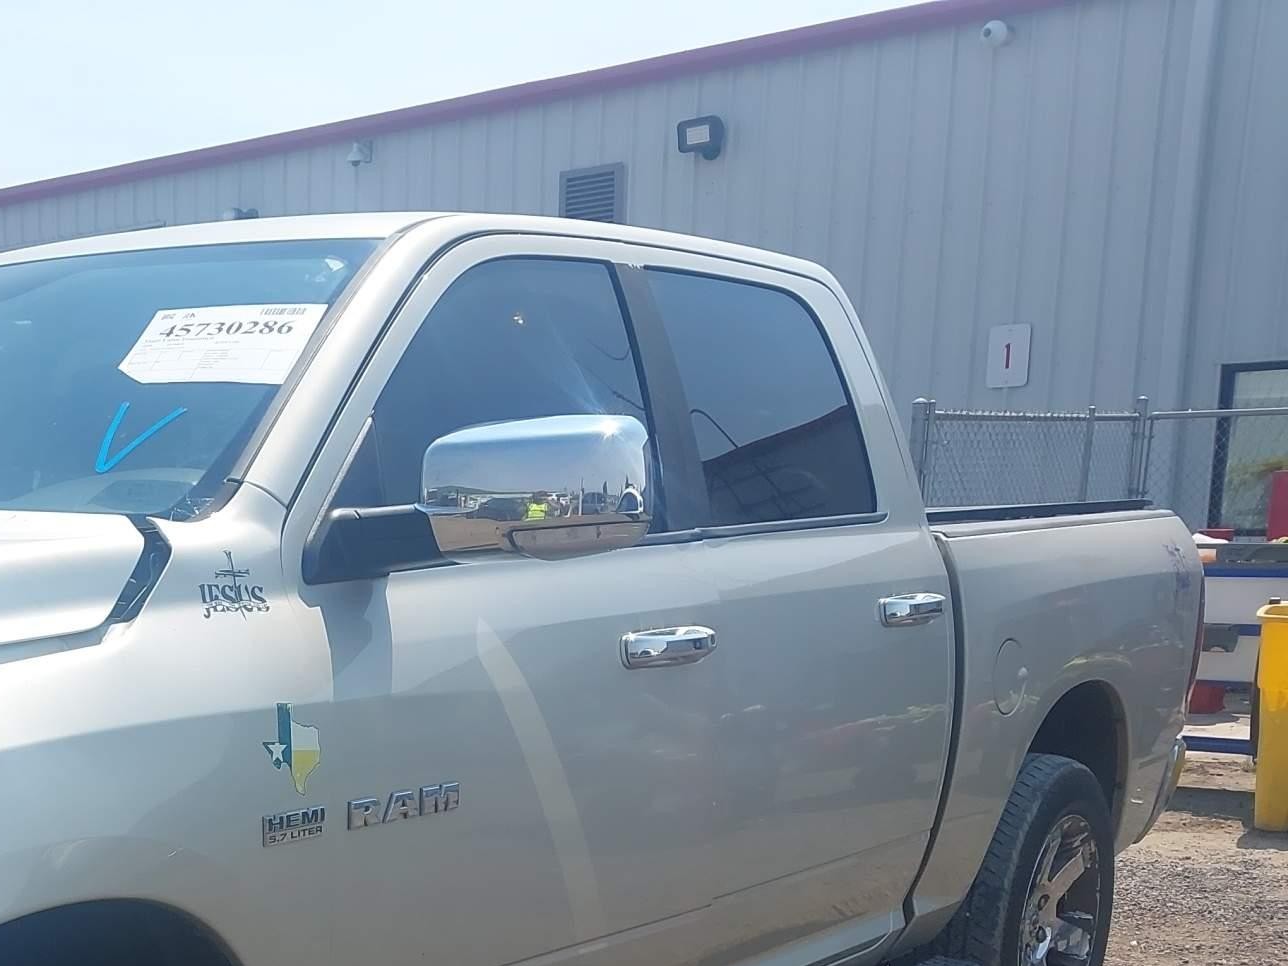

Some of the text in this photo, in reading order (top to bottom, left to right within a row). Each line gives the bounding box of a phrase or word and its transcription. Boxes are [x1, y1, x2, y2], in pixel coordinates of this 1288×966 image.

[159, 319, 294, 338] 45730286
[1004, 342, 1012, 369] 1
[198, 583, 270, 619] JESUS
[266, 806, 326, 833] HEMI
[346, 781, 461, 831] RAM
[268, 825, 324, 845] 5.7 LITER
